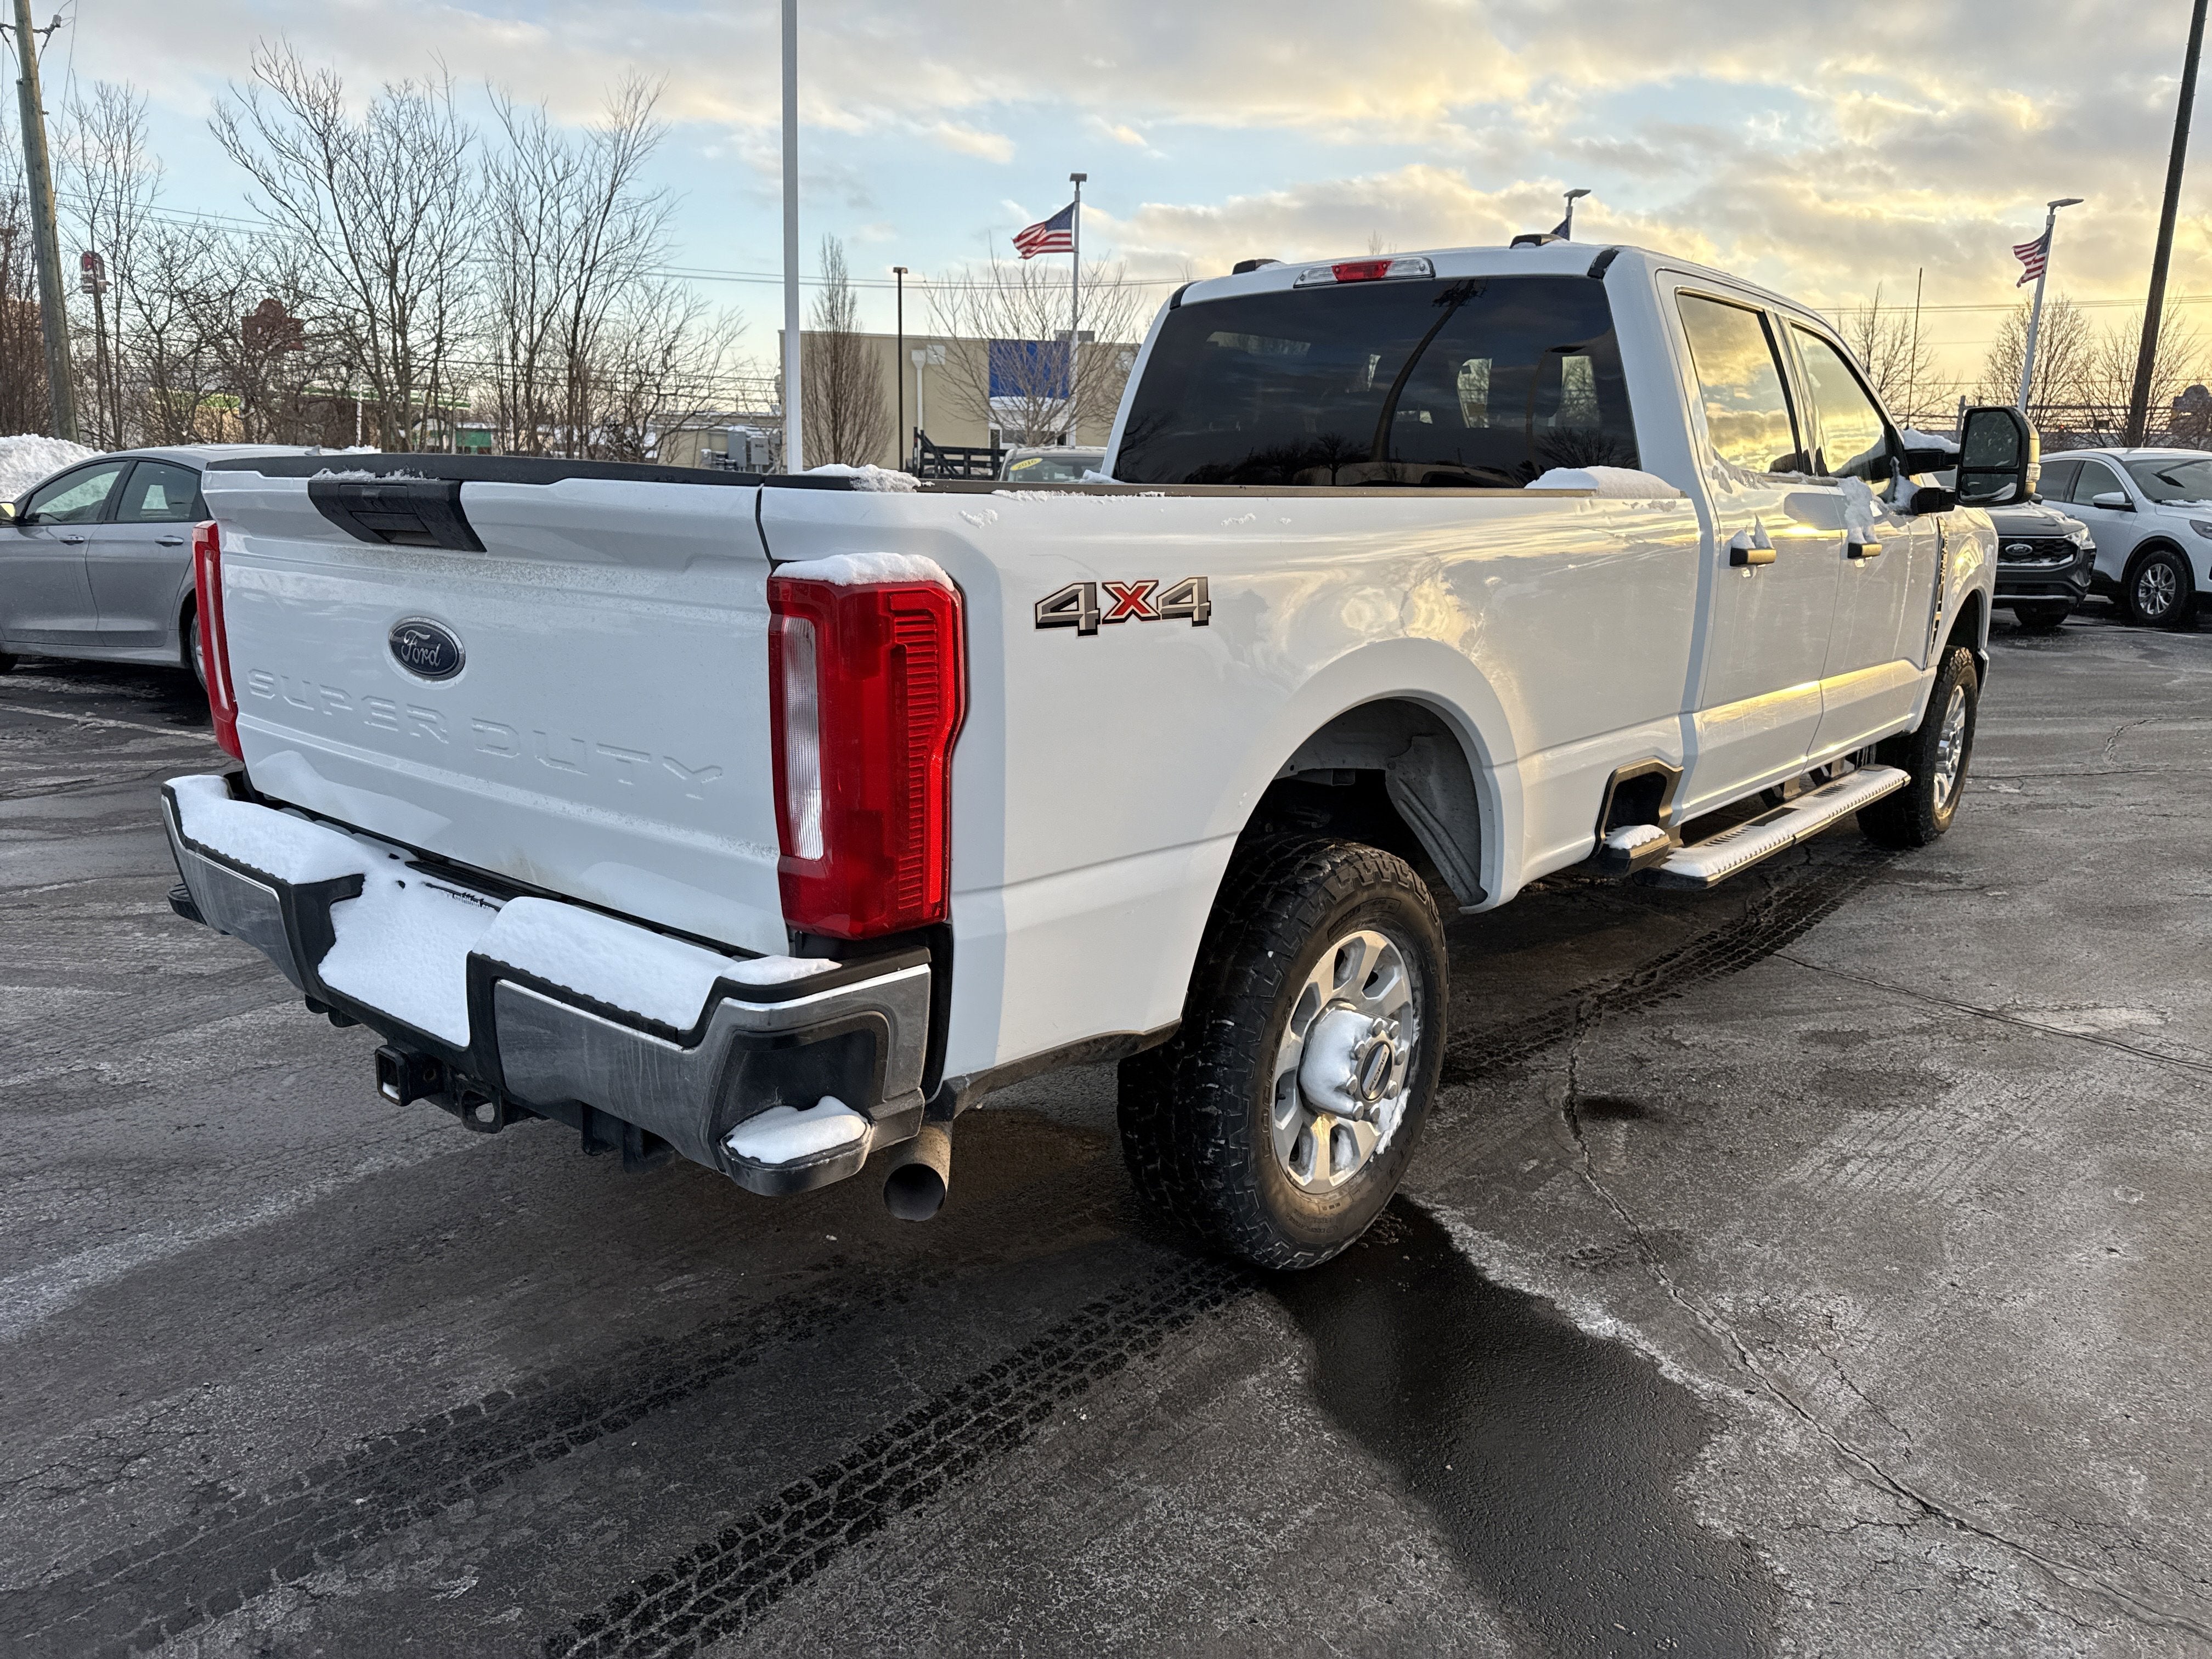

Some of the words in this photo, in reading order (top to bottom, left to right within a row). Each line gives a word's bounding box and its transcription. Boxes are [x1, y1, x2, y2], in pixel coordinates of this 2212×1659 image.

[401, 629, 441, 667] Ford
[249, 669, 448, 743] SUPER
[472, 718, 723, 800] DUTY
[1262, 995, 1293, 1159] COOPER
